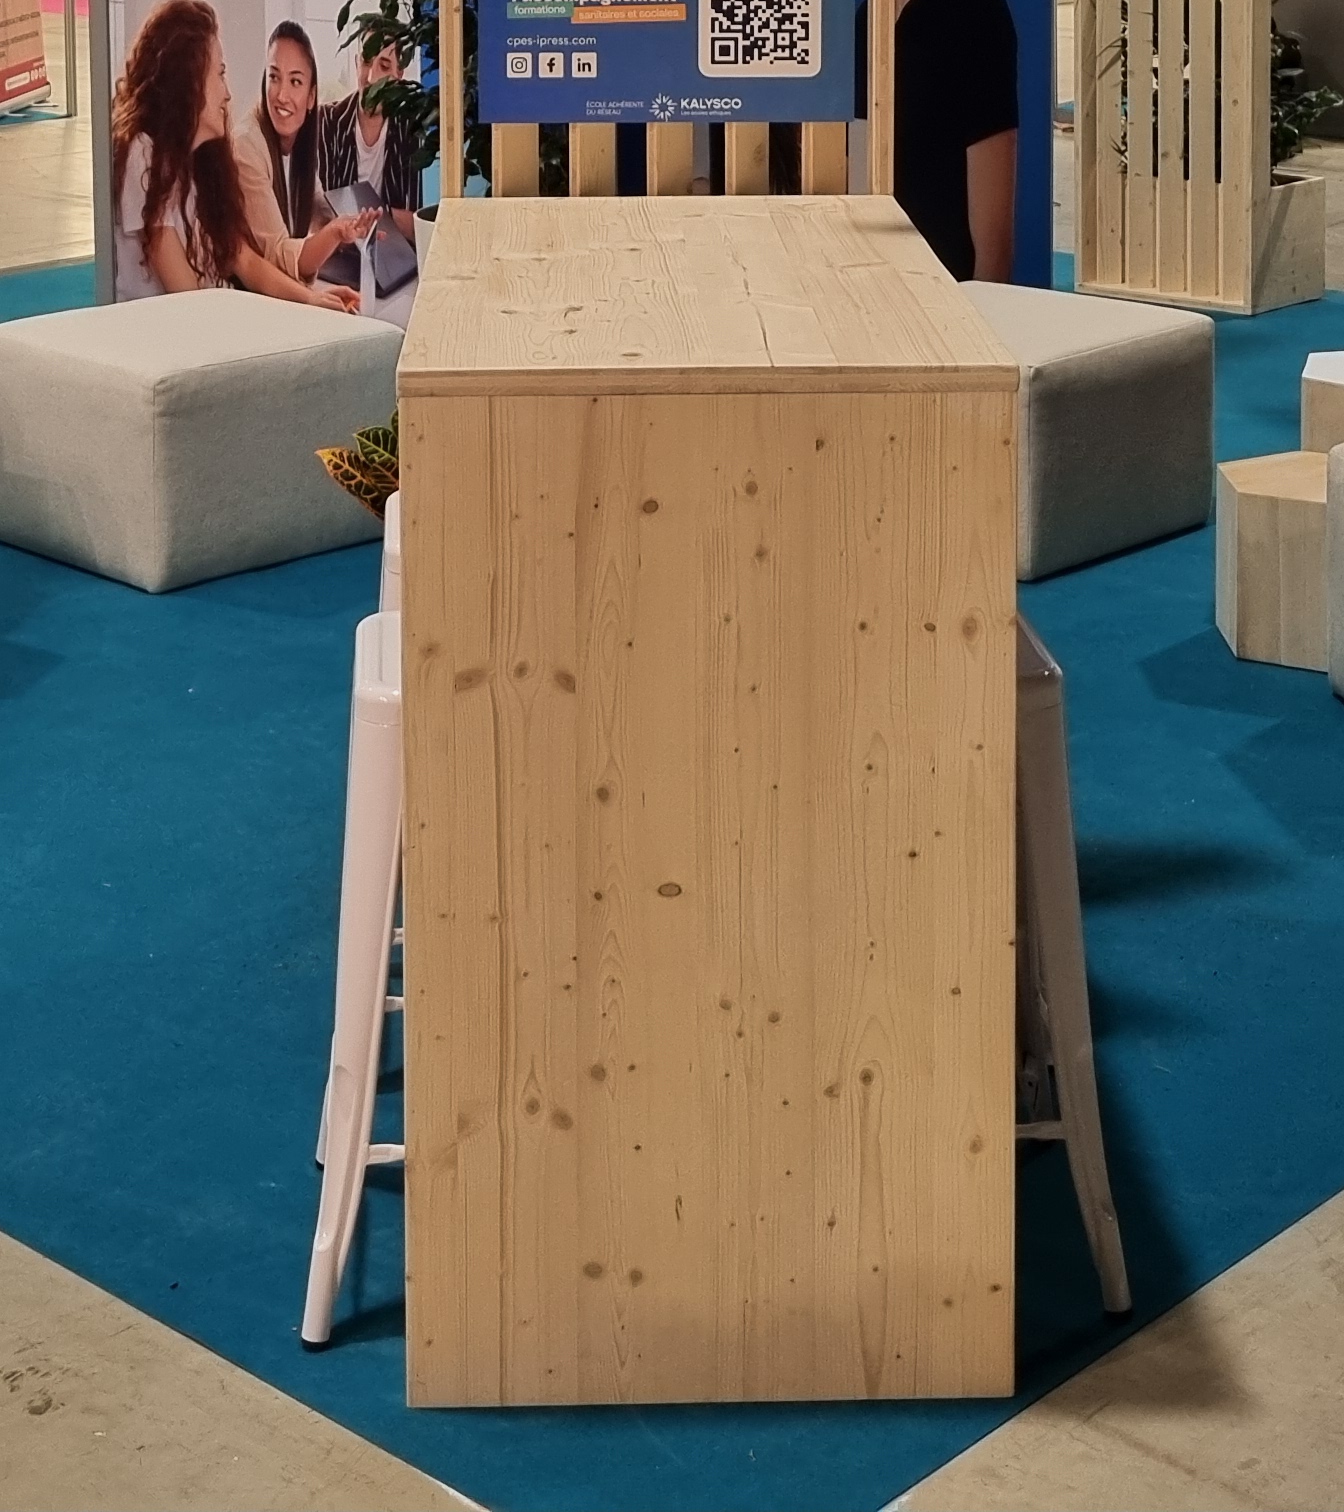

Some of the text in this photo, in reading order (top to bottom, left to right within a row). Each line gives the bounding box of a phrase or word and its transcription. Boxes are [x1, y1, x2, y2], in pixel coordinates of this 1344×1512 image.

[514, 5, 566, 15] formations
[579, 8, 679, 20] sanitaires et sociales
[507, 34, 597, 48] cpes-ipress.com
[680, 97, 742, 109] KALYSCO
